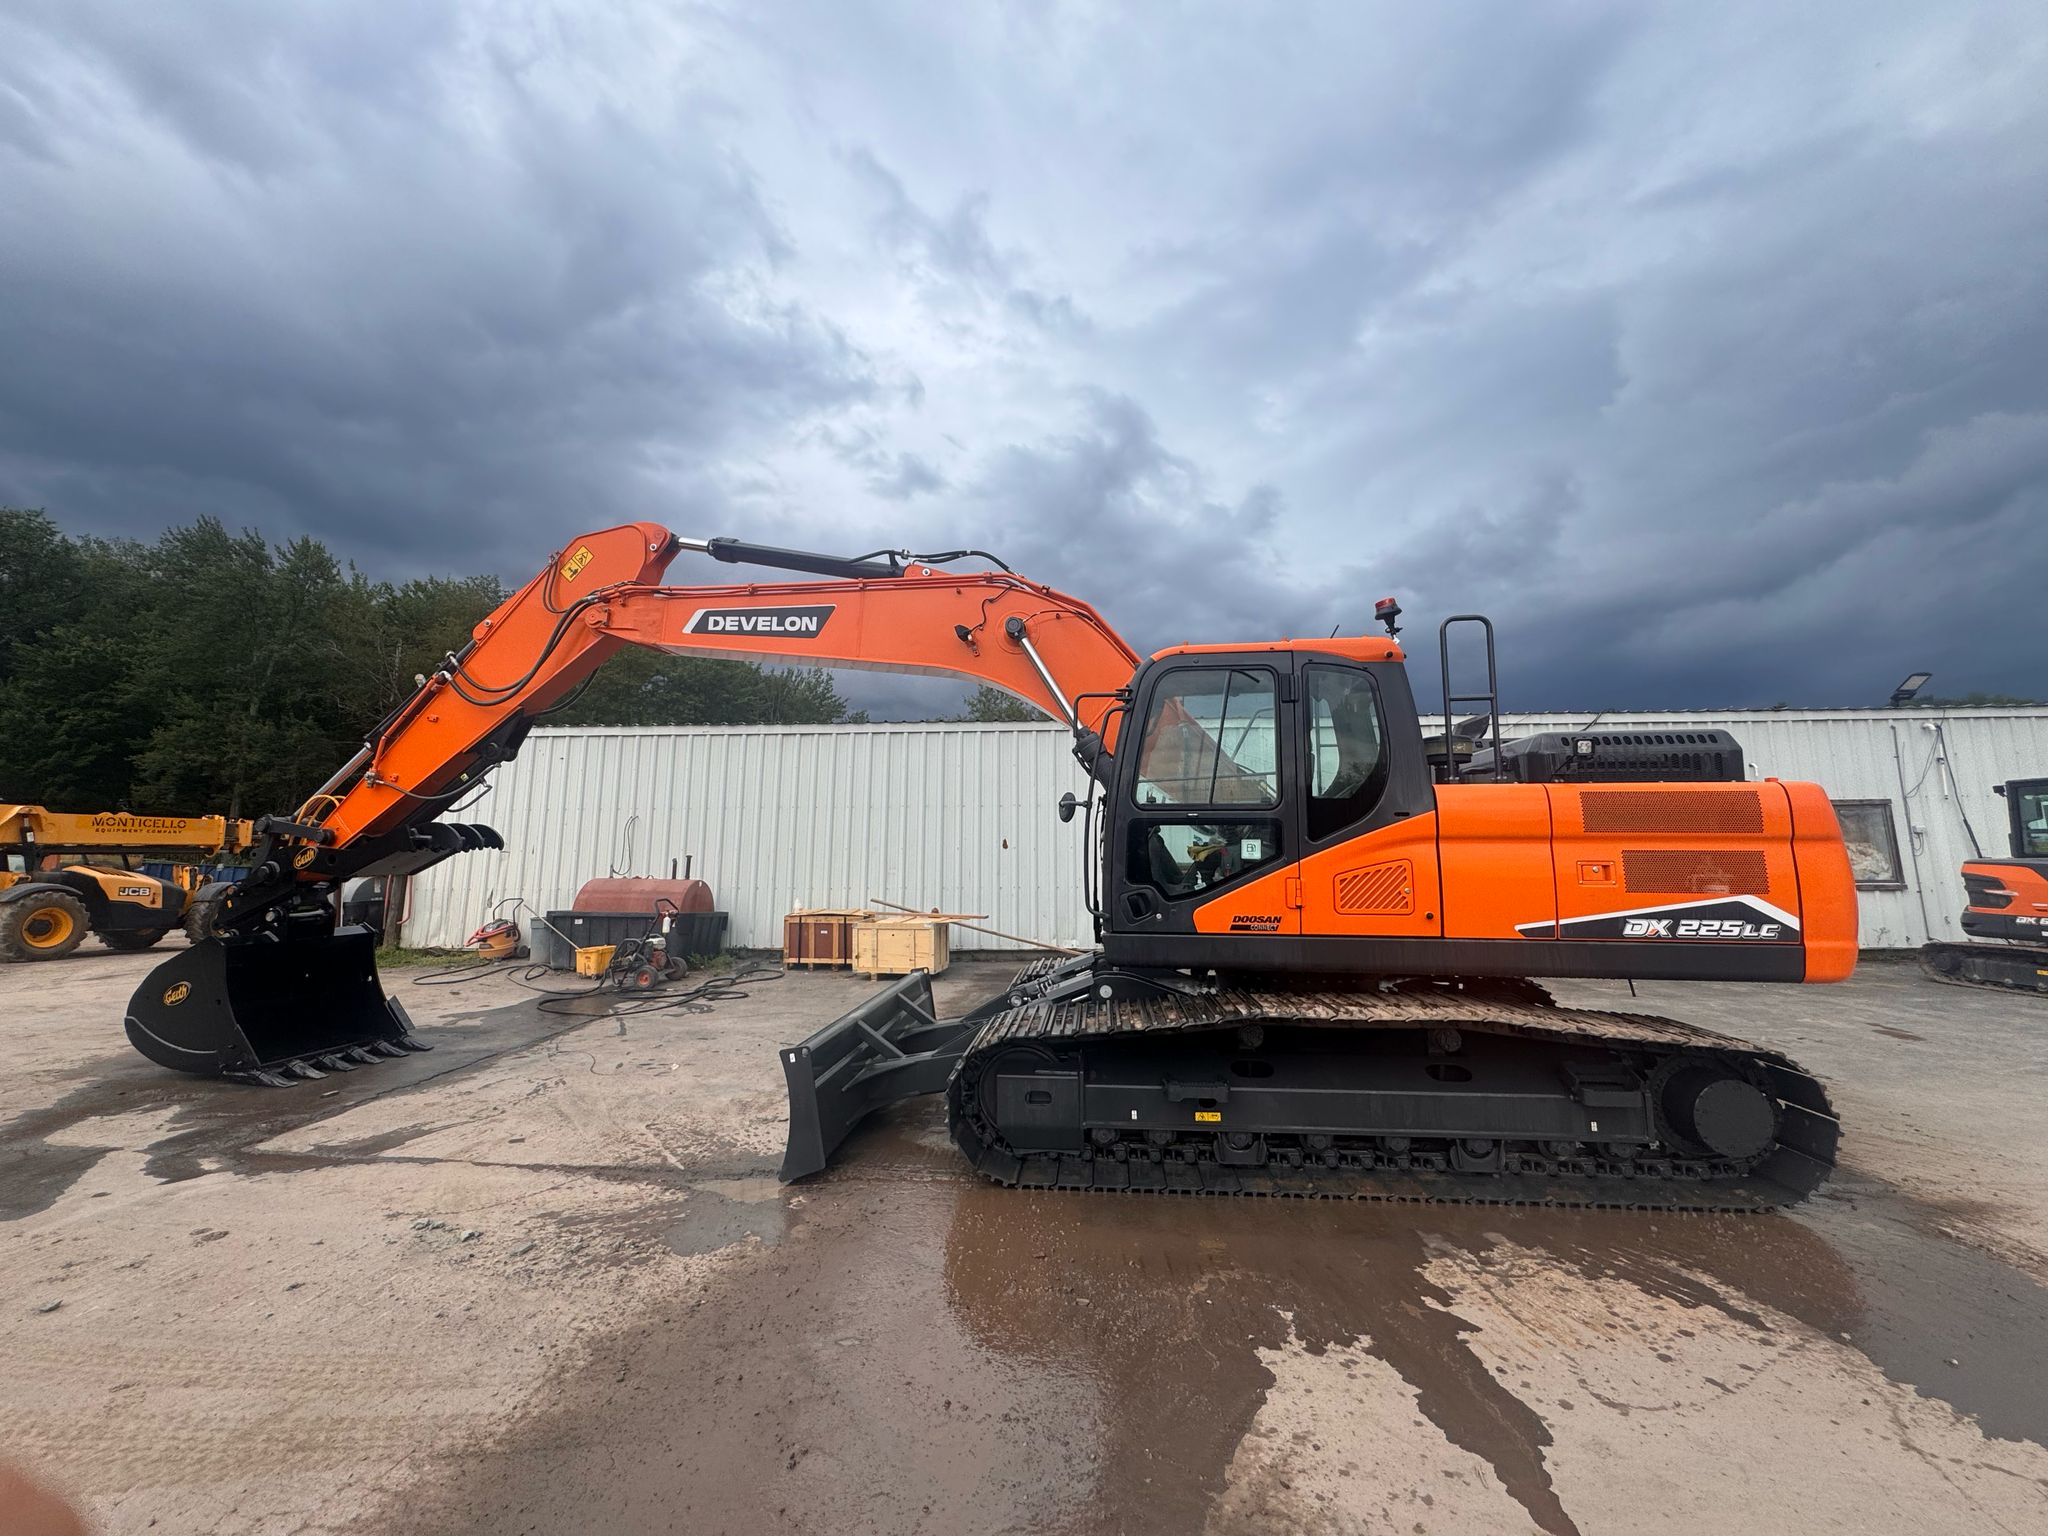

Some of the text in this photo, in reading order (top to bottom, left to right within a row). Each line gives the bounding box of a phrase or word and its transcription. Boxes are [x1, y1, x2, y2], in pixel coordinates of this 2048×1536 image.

[707, 616, 818, 632] DEVELON
[92, 816, 187, 829] MONTICELLO
[119, 887, 151, 896] JCB
[1232, 915, 1282, 923] DOOSAN
[1623, 918, 1673, 938] DX
